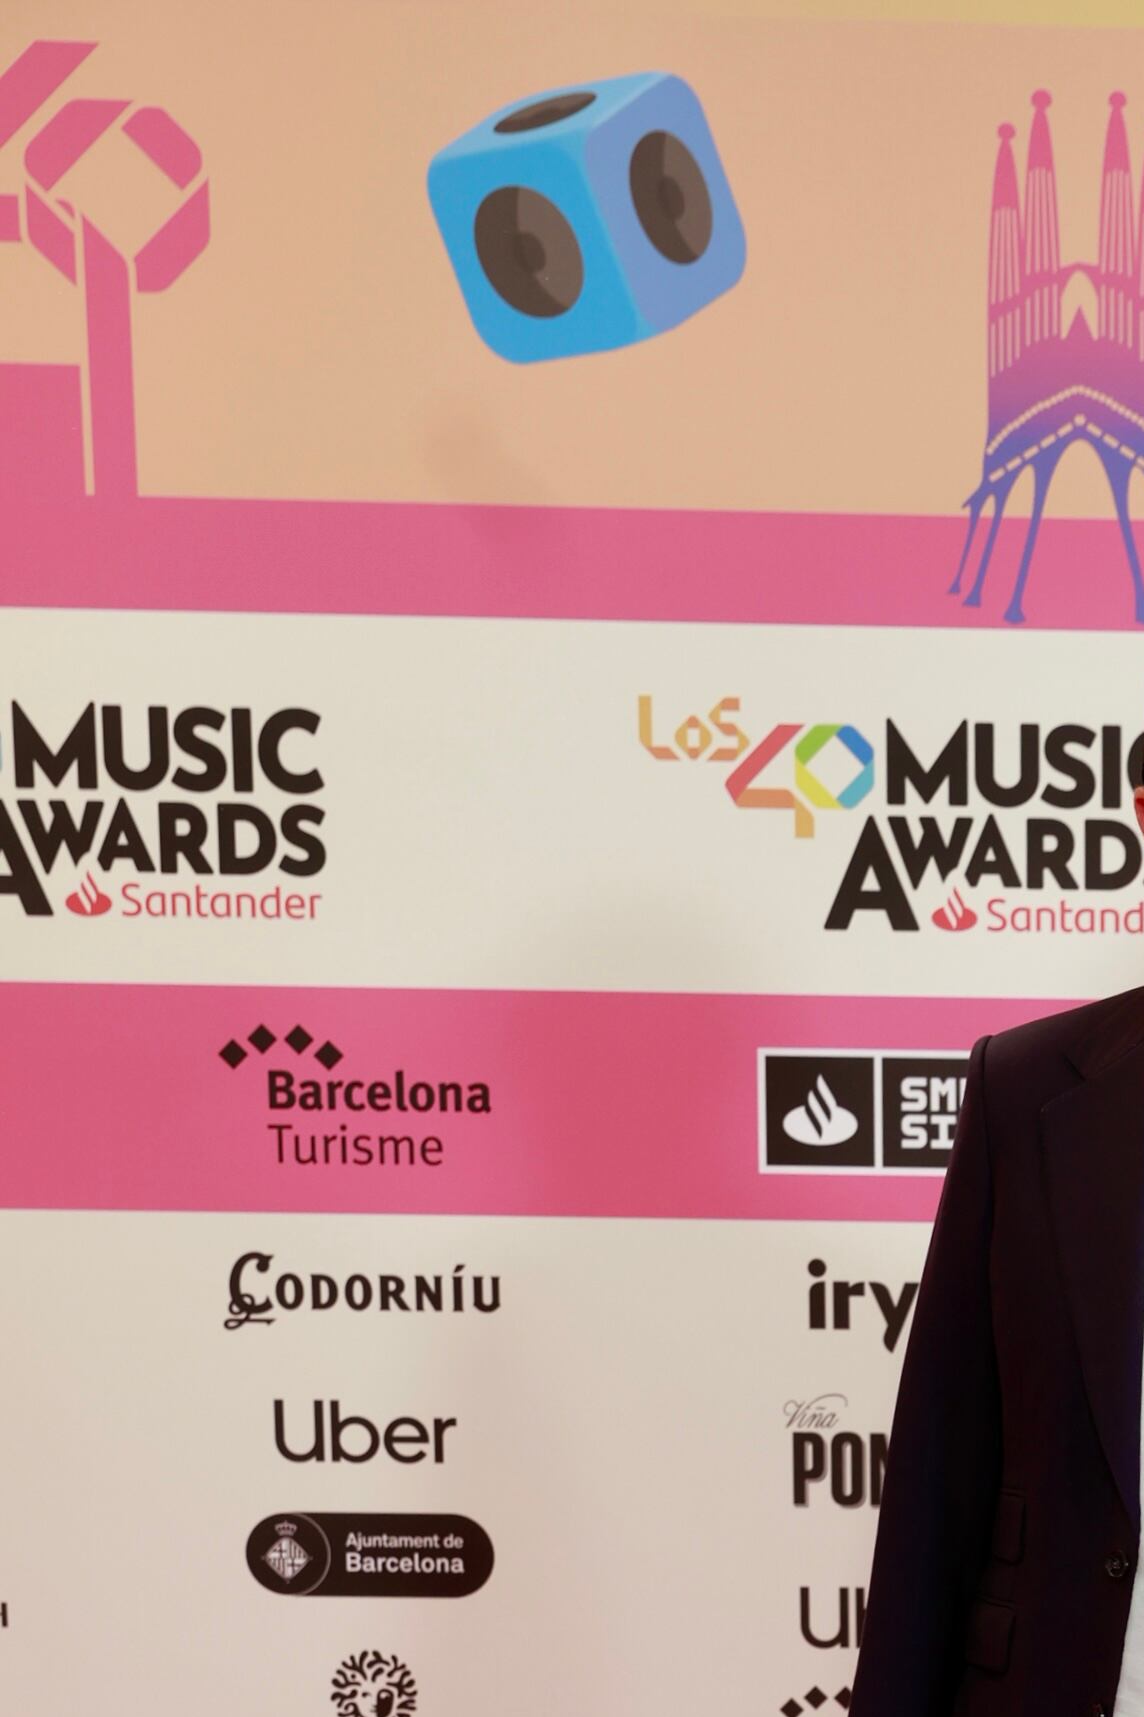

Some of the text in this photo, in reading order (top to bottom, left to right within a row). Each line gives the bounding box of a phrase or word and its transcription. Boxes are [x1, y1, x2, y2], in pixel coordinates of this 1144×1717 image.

[10, 698, 326, 796] MUSIC
[120, 883, 323, 919] Santander
[267, 1069, 492, 1114] Barcelona
[267, 1124, 444, 1167] Turisme
[273, 1399, 457, 1465] Uber
[345, 1531, 464, 1551] Ajuntament de
[345, 1551, 465, 1574] Barcelona
